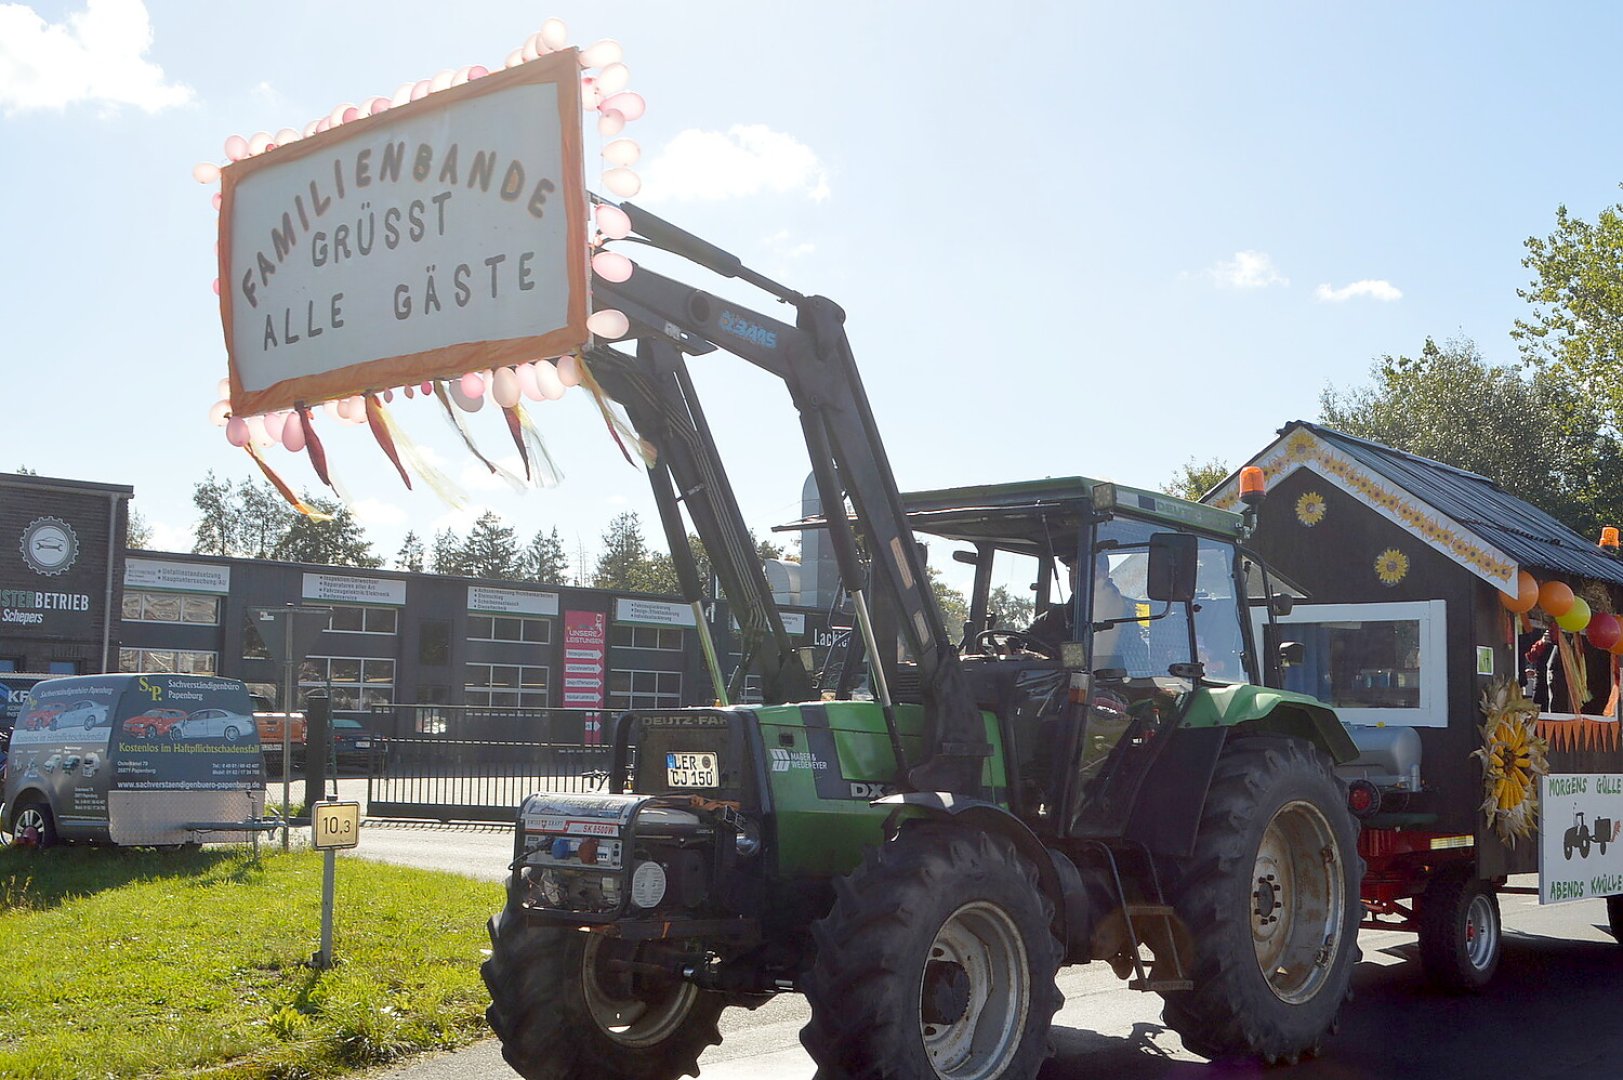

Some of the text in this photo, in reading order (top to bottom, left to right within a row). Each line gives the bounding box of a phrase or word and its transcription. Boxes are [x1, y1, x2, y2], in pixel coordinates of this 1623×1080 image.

[241, 141, 556, 308] FAMILIENBANDE
[311, 191, 453, 267] GRÜSST
[263, 252, 536, 351] ALLE GÄSTE
[2, 608, 44, 625] Schepers
[566, 637, 604, 645] LEISTUNGEN
[569, 630, 597, 638] UNSERE
[168, 680, 240, 691] Sachverständigenbüro
[168, 690, 204, 701] Papenburg
[119, 743, 159, 753] Kostenlos
[161, 743, 172, 753] im
[173, 743, 260, 754] Haftpflichtschadensfall
[674, 755, 697, 770] LER
[117, 780, 260, 790] www.sachverstaendigenbuero-papenburg.de
[672, 771, 713, 786] CJ 150
[1548, 774, 1622, 797] MORGENS GÜLLE
[1549, 880, 1585, 901] ABENDS
